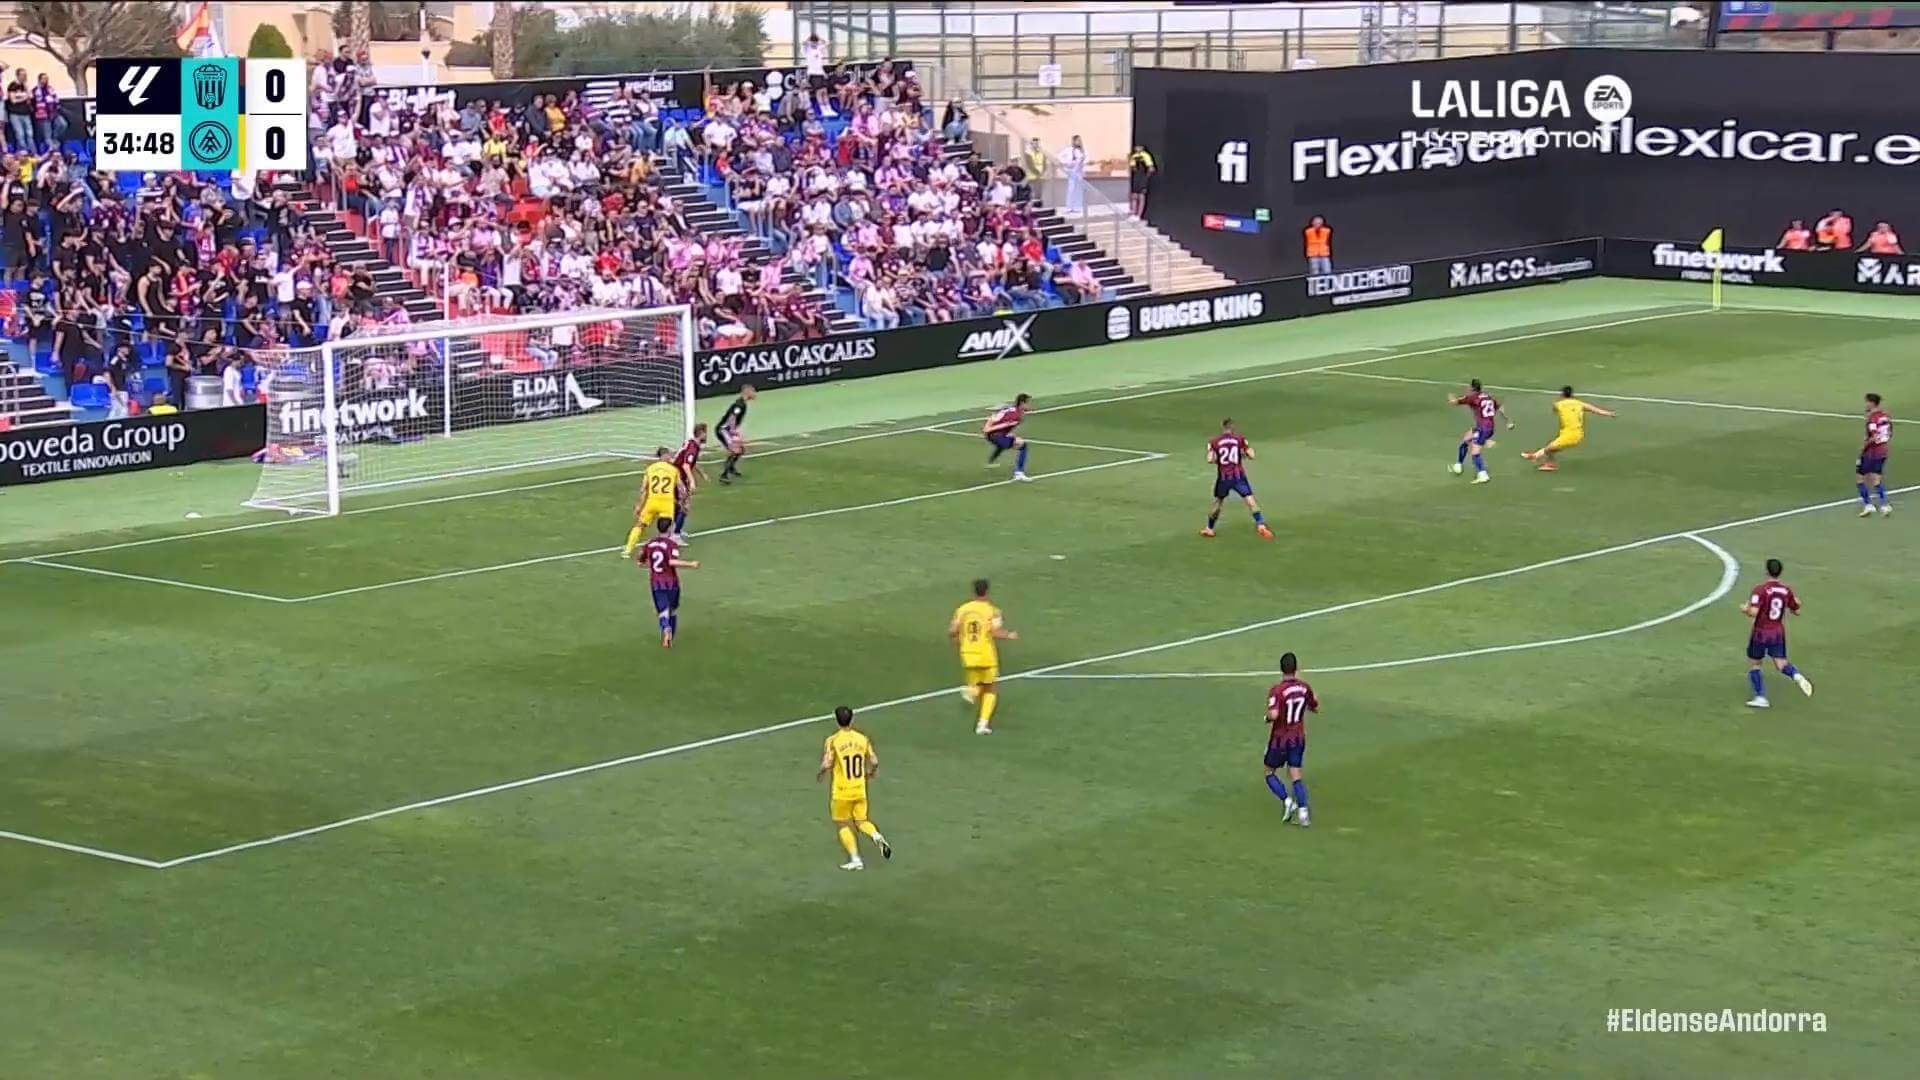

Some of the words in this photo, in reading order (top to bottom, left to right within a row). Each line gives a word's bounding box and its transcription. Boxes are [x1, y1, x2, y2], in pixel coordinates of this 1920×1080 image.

[1217, 140, 1249, 183] fi
[1653, 243, 1785, 273] finetwork
[1450, 257, 1536, 288] MARCOS
[1139, 298, 1212, 332] BURGER
[1213, 292, 1264, 322] KING
[730, 351, 782, 374] CASA
[785, 338, 876, 367] CASCALES
[513, 375, 559, 398] ELDA
[103, 422, 186, 450] Group
[22, 459, 71, 477] TEXTILE
[73, 450, 152, 471] INNOVATION
[1219, 446, 1239, 465] 24
[651, 475, 671, 494] 22
[652, 551, 664, 572] 2
[1769, 598, 1783, 620] 8
[1286, 696, 1305, 724] 17
[843, 754, 862, 780] 10
